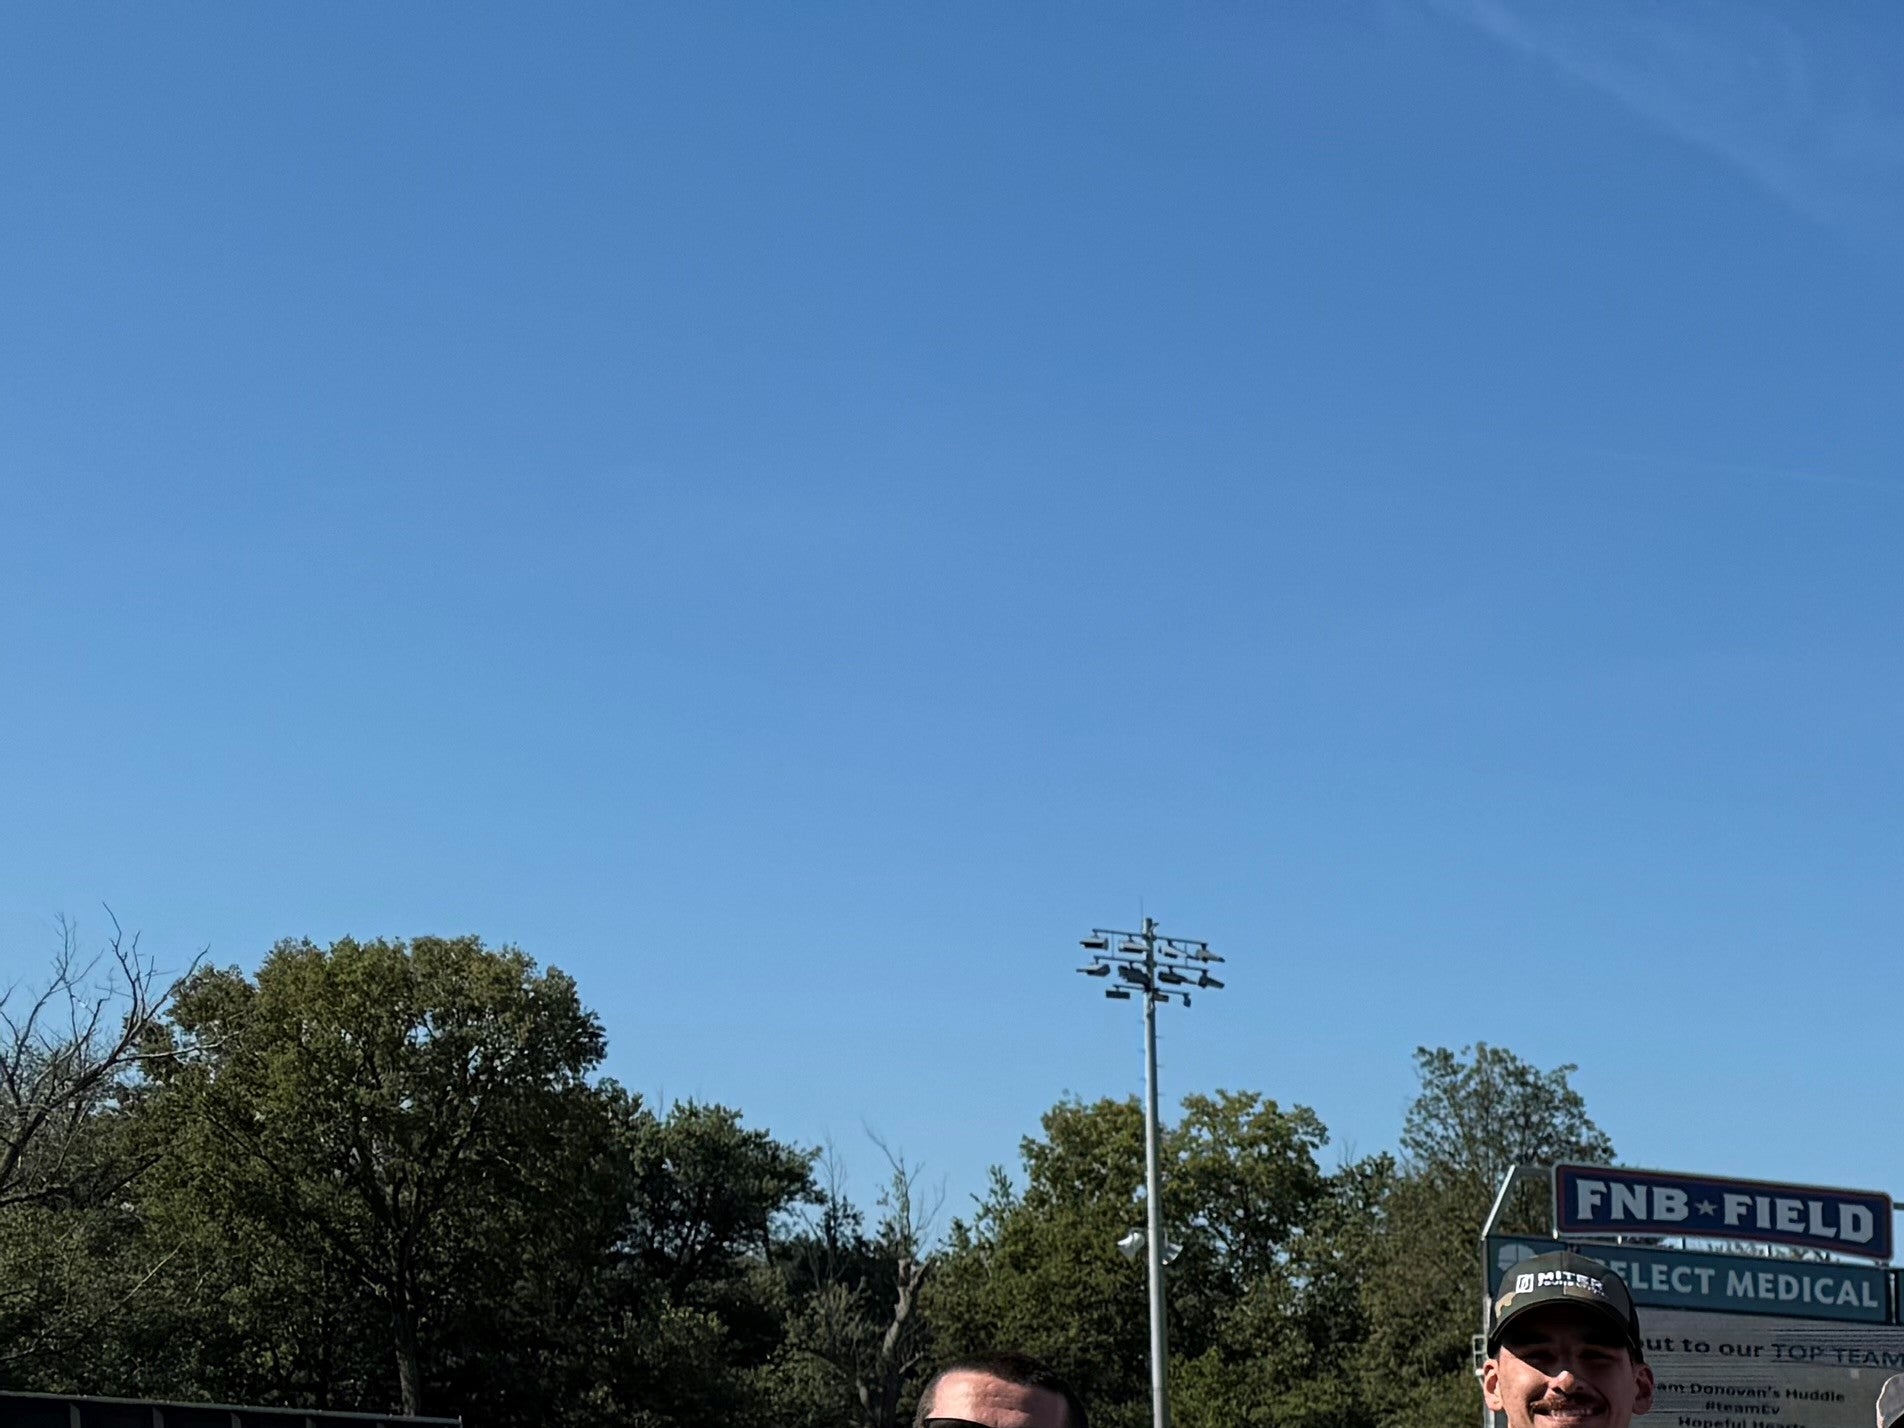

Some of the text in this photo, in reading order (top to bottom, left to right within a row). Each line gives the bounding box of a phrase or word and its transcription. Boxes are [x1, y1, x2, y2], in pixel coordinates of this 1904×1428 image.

[1576, 1179, 1874, 1243] FNB FIELD
[1727, 1271, 1878, 1308] MEDICAL
[1683, 1339, 1710, 1353] to
[1719, 1343, 1763, 1357] our
[1772, 1343, 1825, 1361] TOP
[1690, 1382, 1780, 1398] Donovan's
[1786, 1389, 1845, 1402] Huddle
